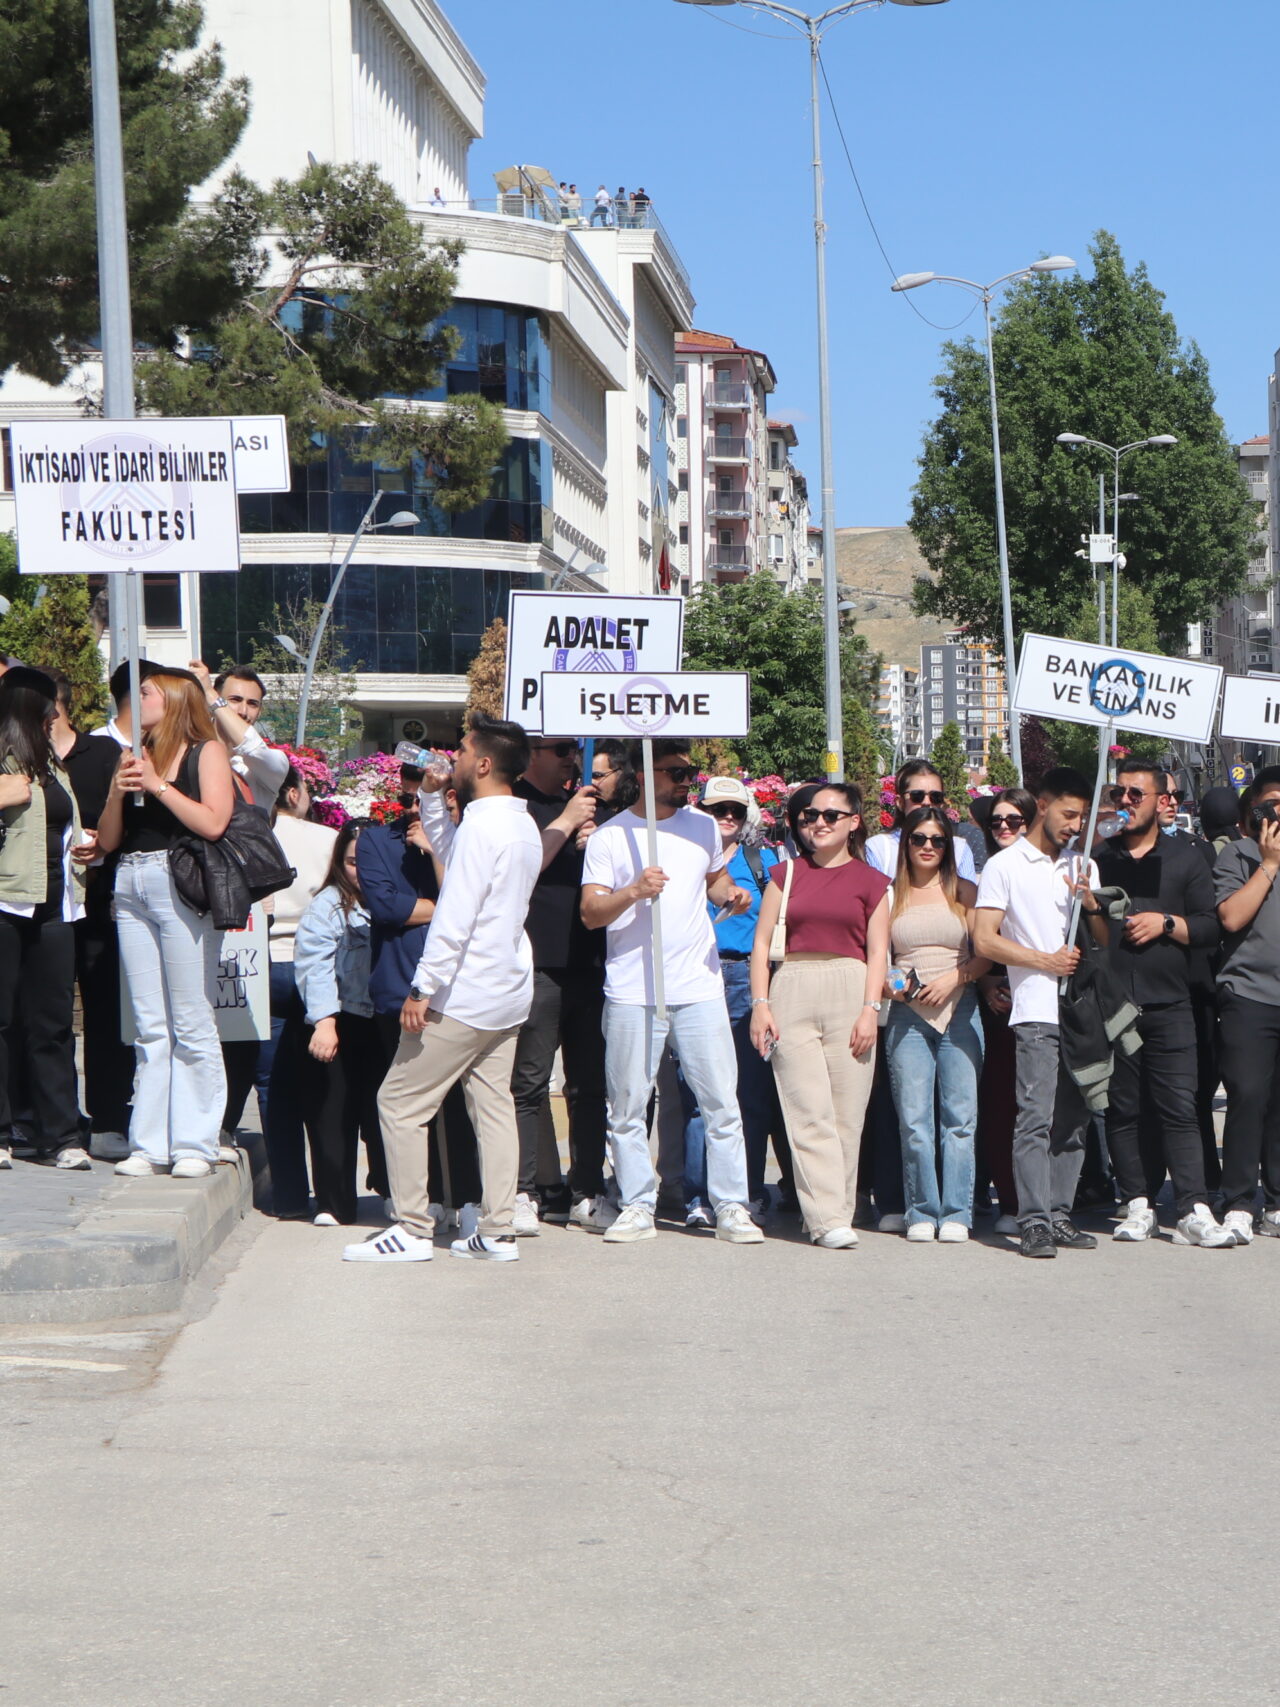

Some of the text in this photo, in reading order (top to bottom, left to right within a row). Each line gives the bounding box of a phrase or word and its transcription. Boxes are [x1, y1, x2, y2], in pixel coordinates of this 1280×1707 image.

[19, 443, 228, 483] İKTİSADİ VE İDARİ BİLİMLER
[61, 502, 195, 541] FAKÜLTESİ
[544, 616, 649, 650] ADALET
[1045, 654, 1193, 697] BANKACILIK
[580, 688, 710, 721] İŞLETME
[1053, 683, 1081, 705] VE
[1090, 687, 1177, 720] FİNANS
